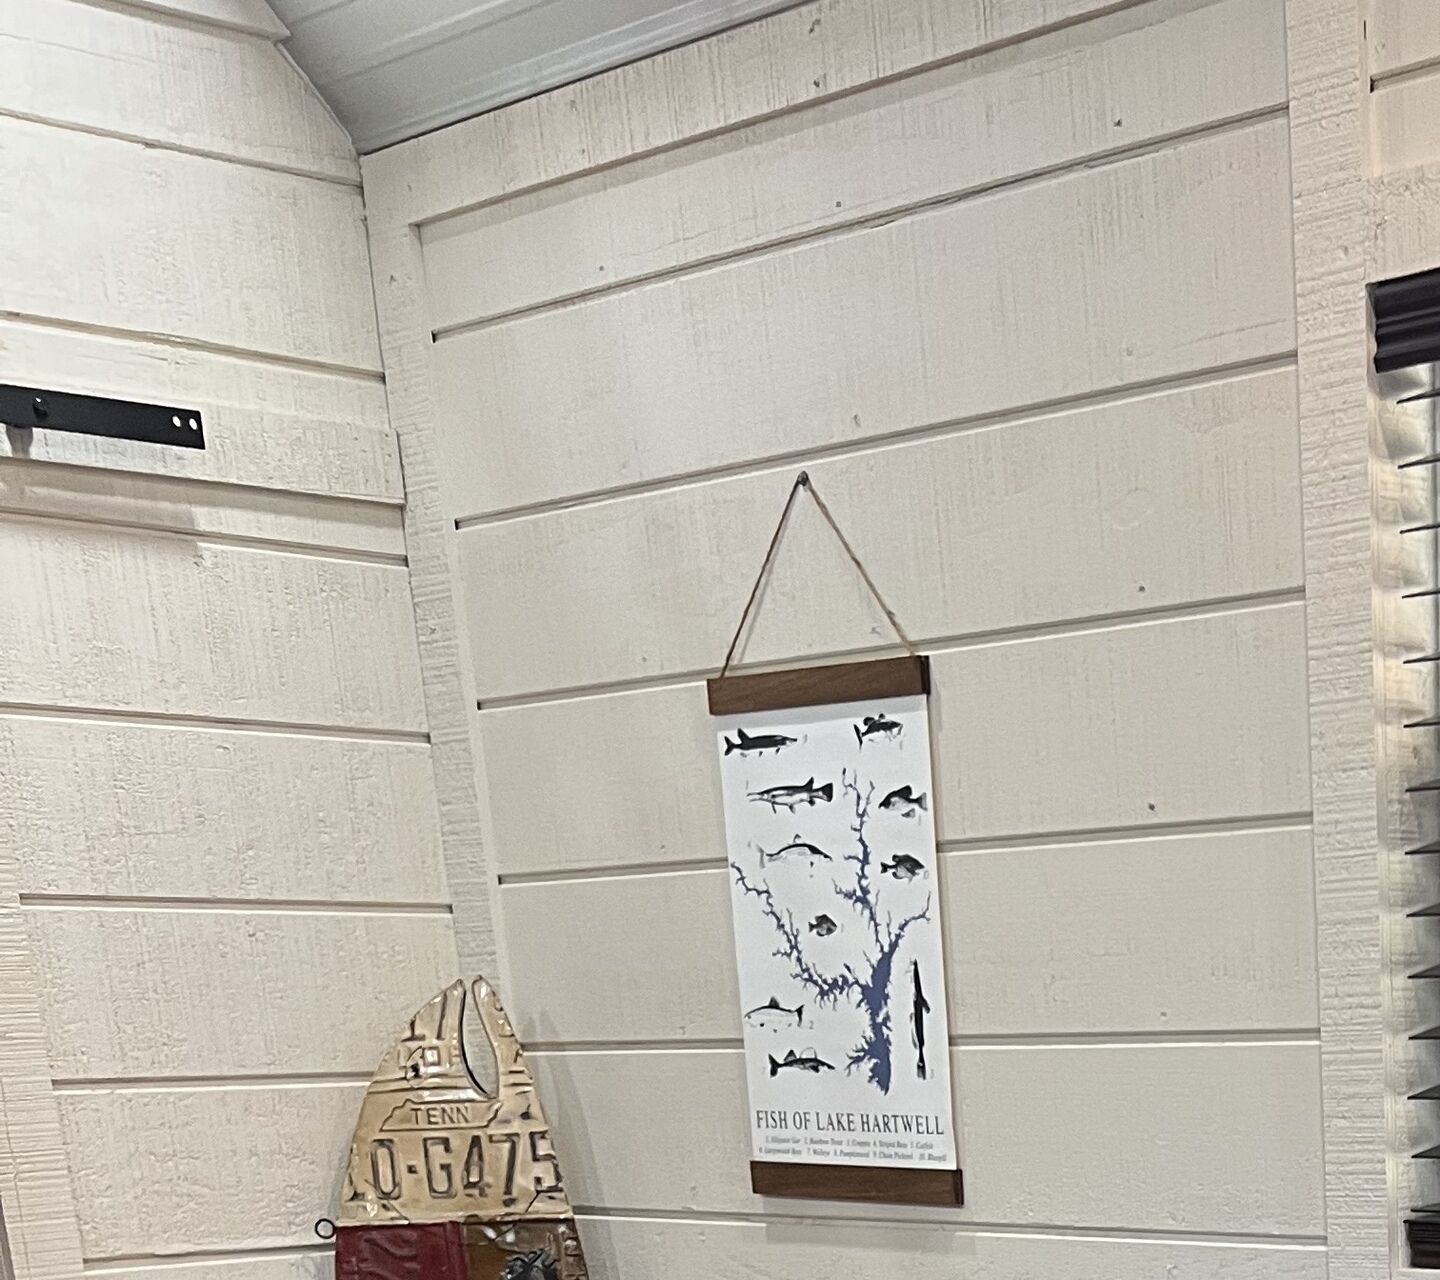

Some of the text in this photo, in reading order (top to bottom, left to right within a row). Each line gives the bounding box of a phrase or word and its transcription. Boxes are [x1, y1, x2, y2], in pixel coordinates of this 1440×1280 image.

[409, 1105, 472, 1126] TENN
[756, 1110, 944, 1135] FISH OF LAKE HARTWELL
